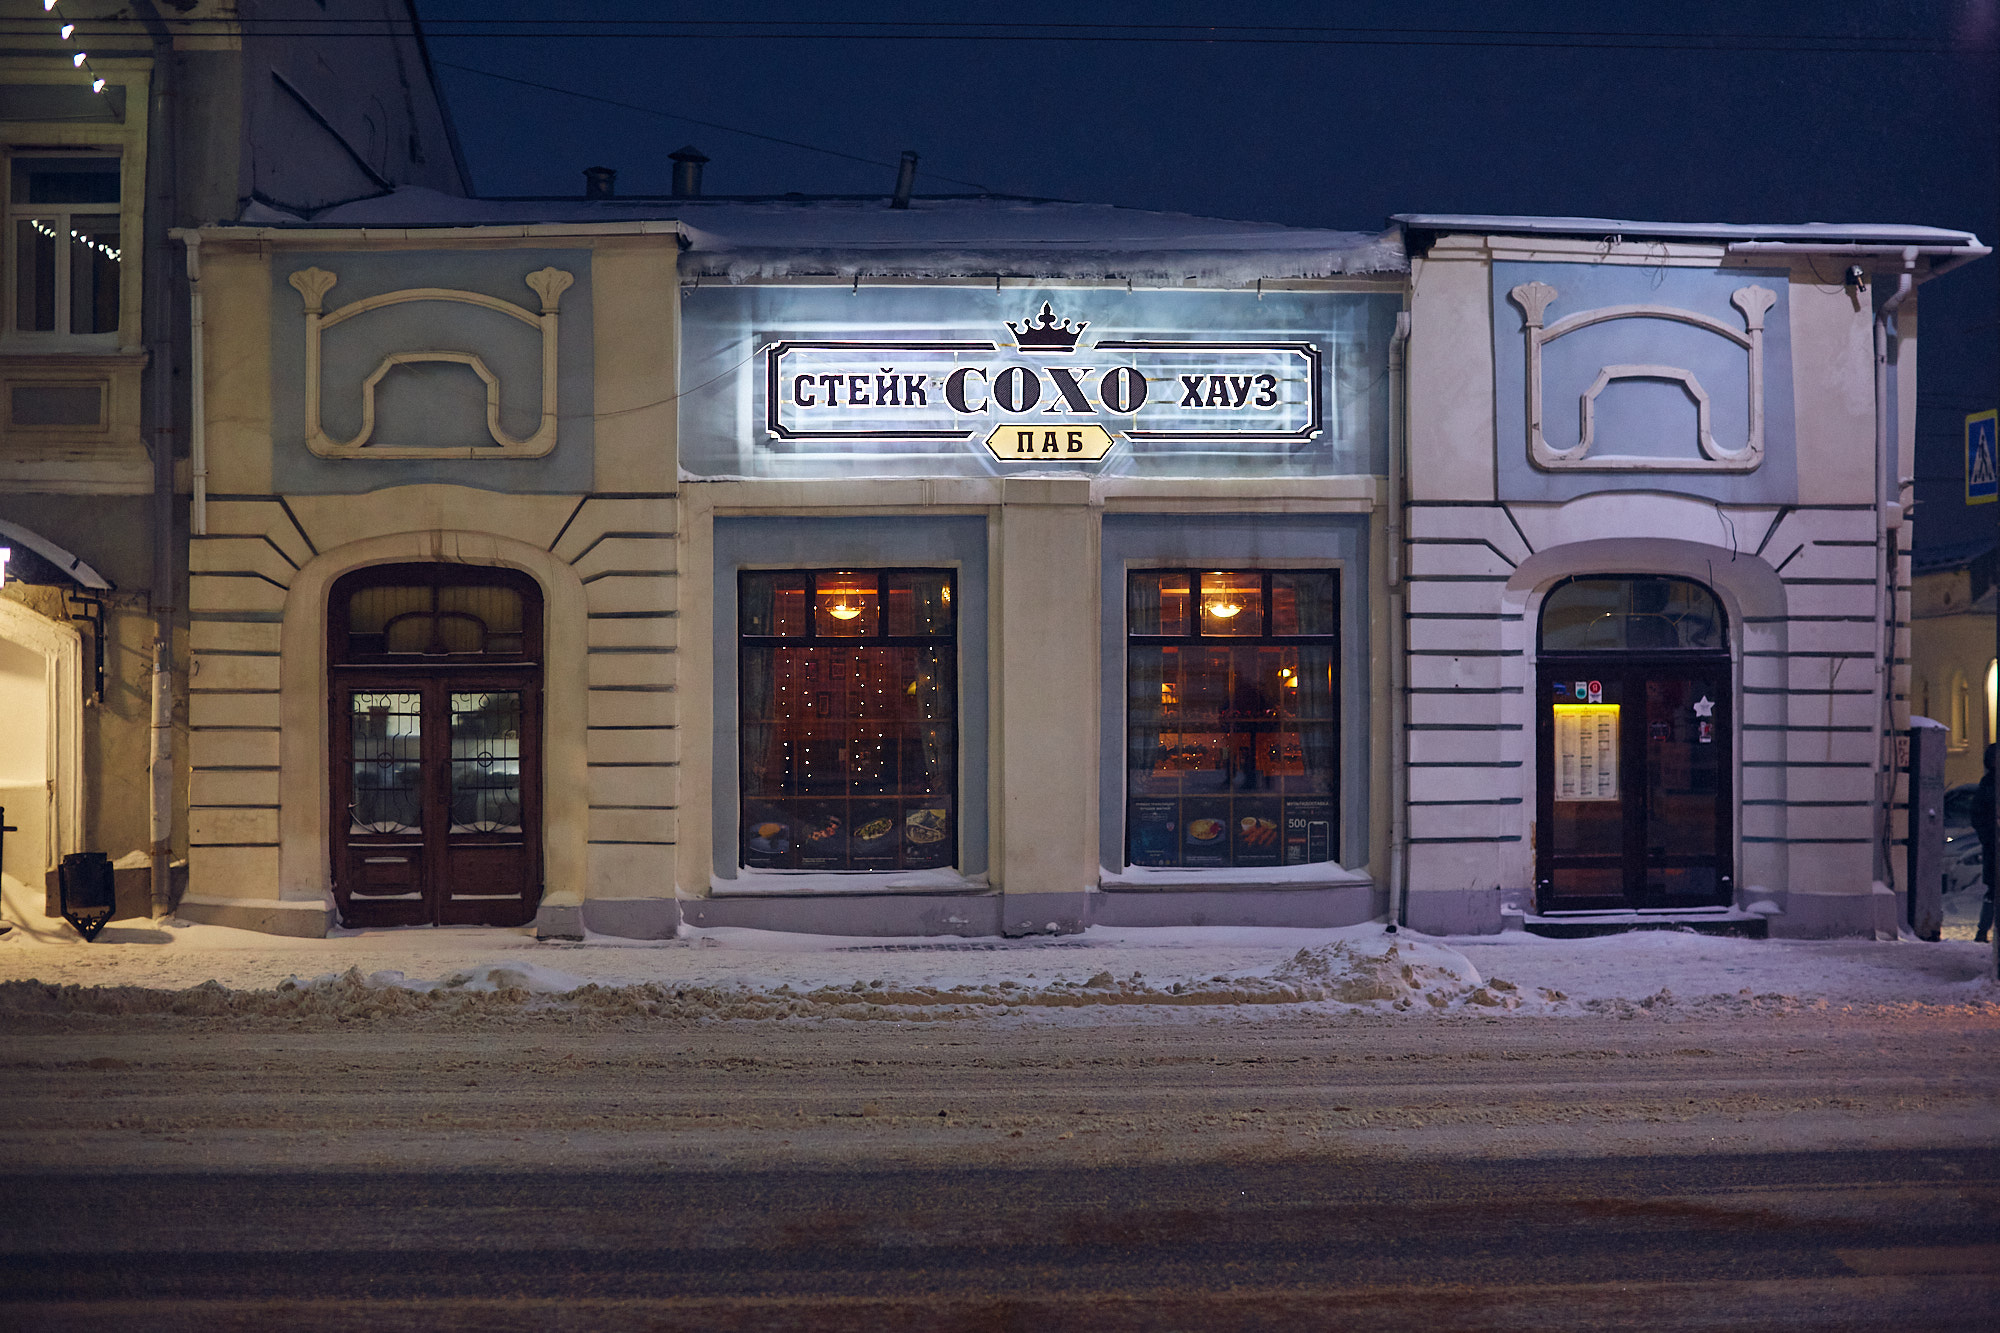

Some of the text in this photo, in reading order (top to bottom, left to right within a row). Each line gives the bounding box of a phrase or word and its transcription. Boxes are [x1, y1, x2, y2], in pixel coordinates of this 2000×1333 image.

[794, 366, 1278, 414] СТЕЙК СОХО ХАУЗ
[1017, 431, 1083, 453] ПАБ
[1288, 818, 1307, 828] 500
